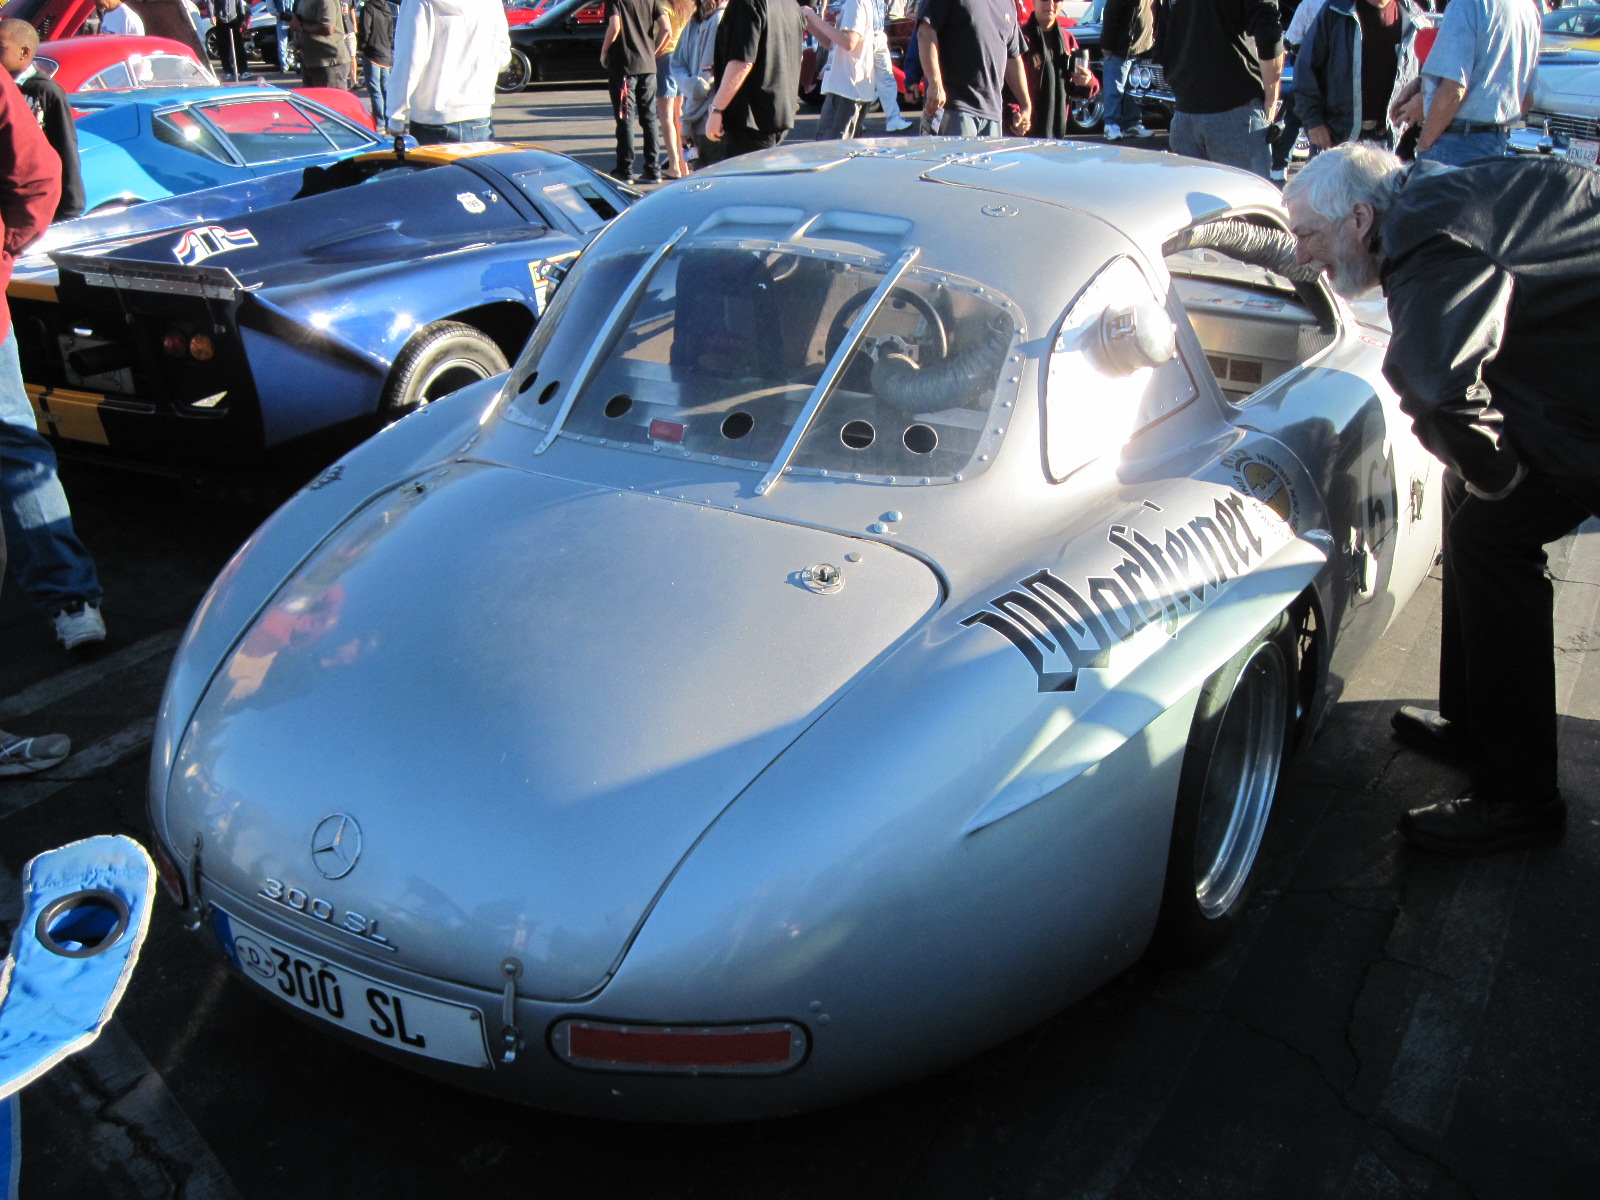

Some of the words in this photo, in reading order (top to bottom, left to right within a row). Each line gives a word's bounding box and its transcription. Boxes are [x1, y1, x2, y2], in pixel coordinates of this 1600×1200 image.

[263, 877, 334, 921] 300
[343, 910, 389, 942] SL
[248, 947, 260, 965] D
[270, 946, 345, 1019] 300
[366, 987, 426, 1049] SL
